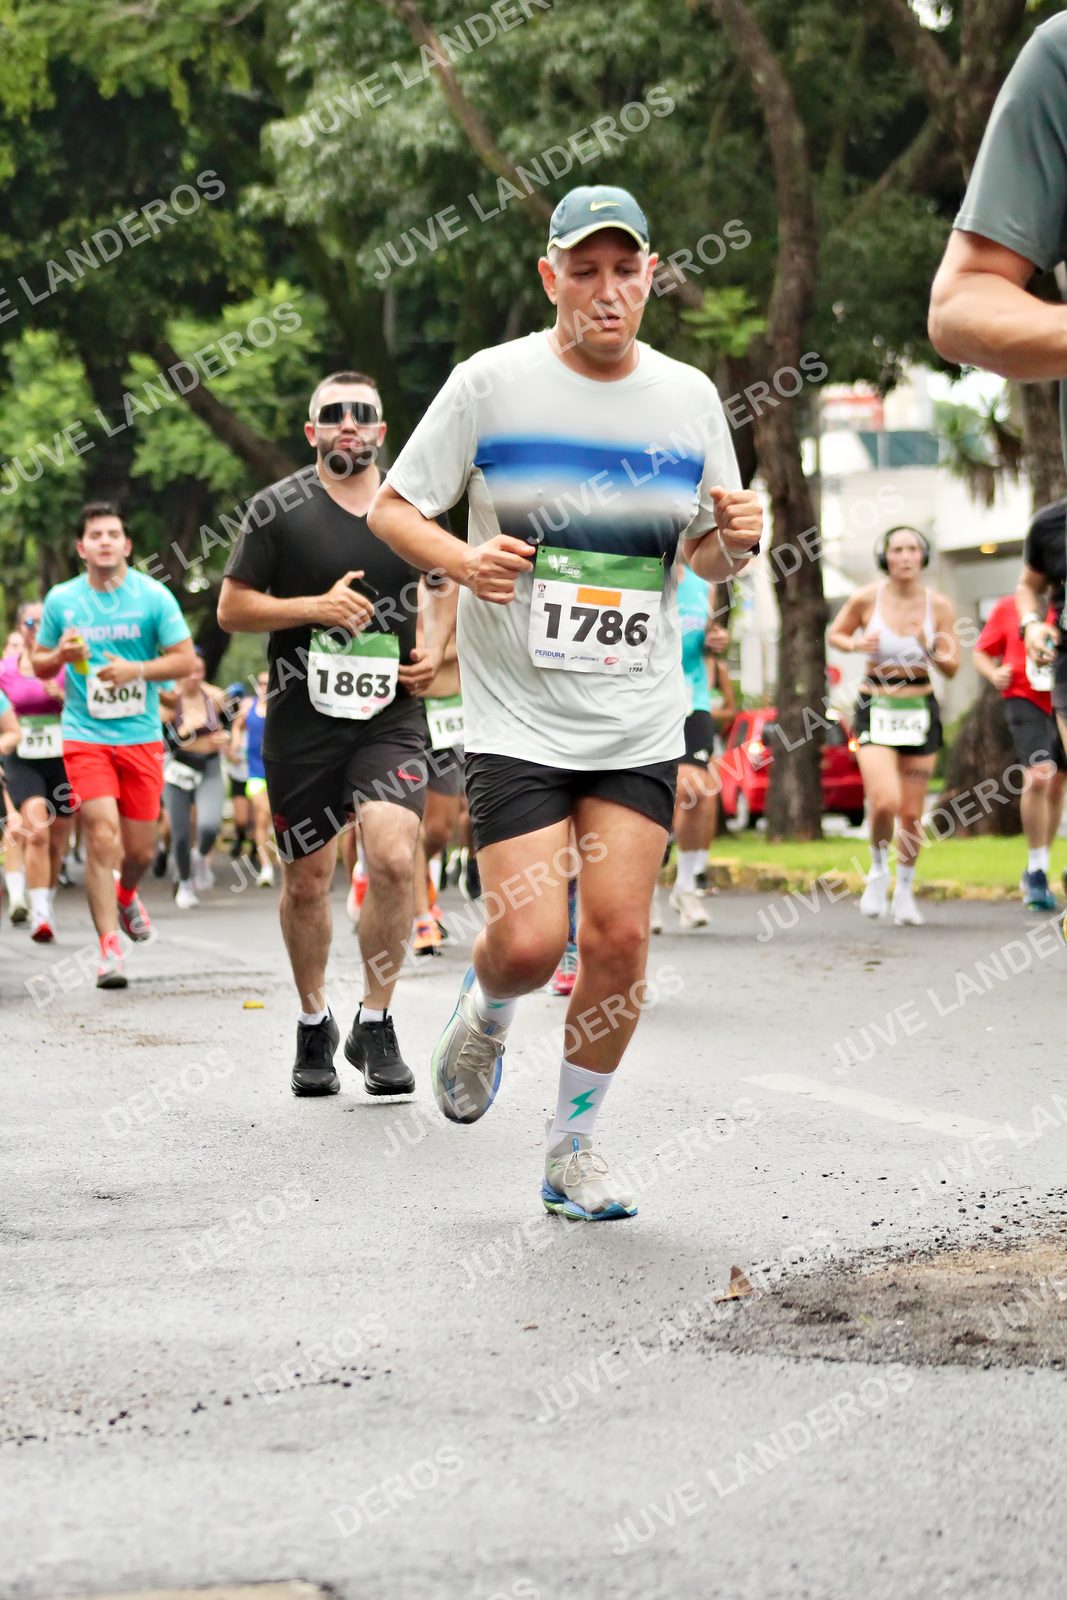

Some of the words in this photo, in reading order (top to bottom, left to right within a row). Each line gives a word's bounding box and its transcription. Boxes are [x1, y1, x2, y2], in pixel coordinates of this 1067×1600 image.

[64, 624, 141, 641] RDURA
[543, 602, 650, 647] 1786
[534, 648, 566, 659] PERDURA
[316, 669, 391, 699] 1863
[93, 685, 142, 704] 4304
